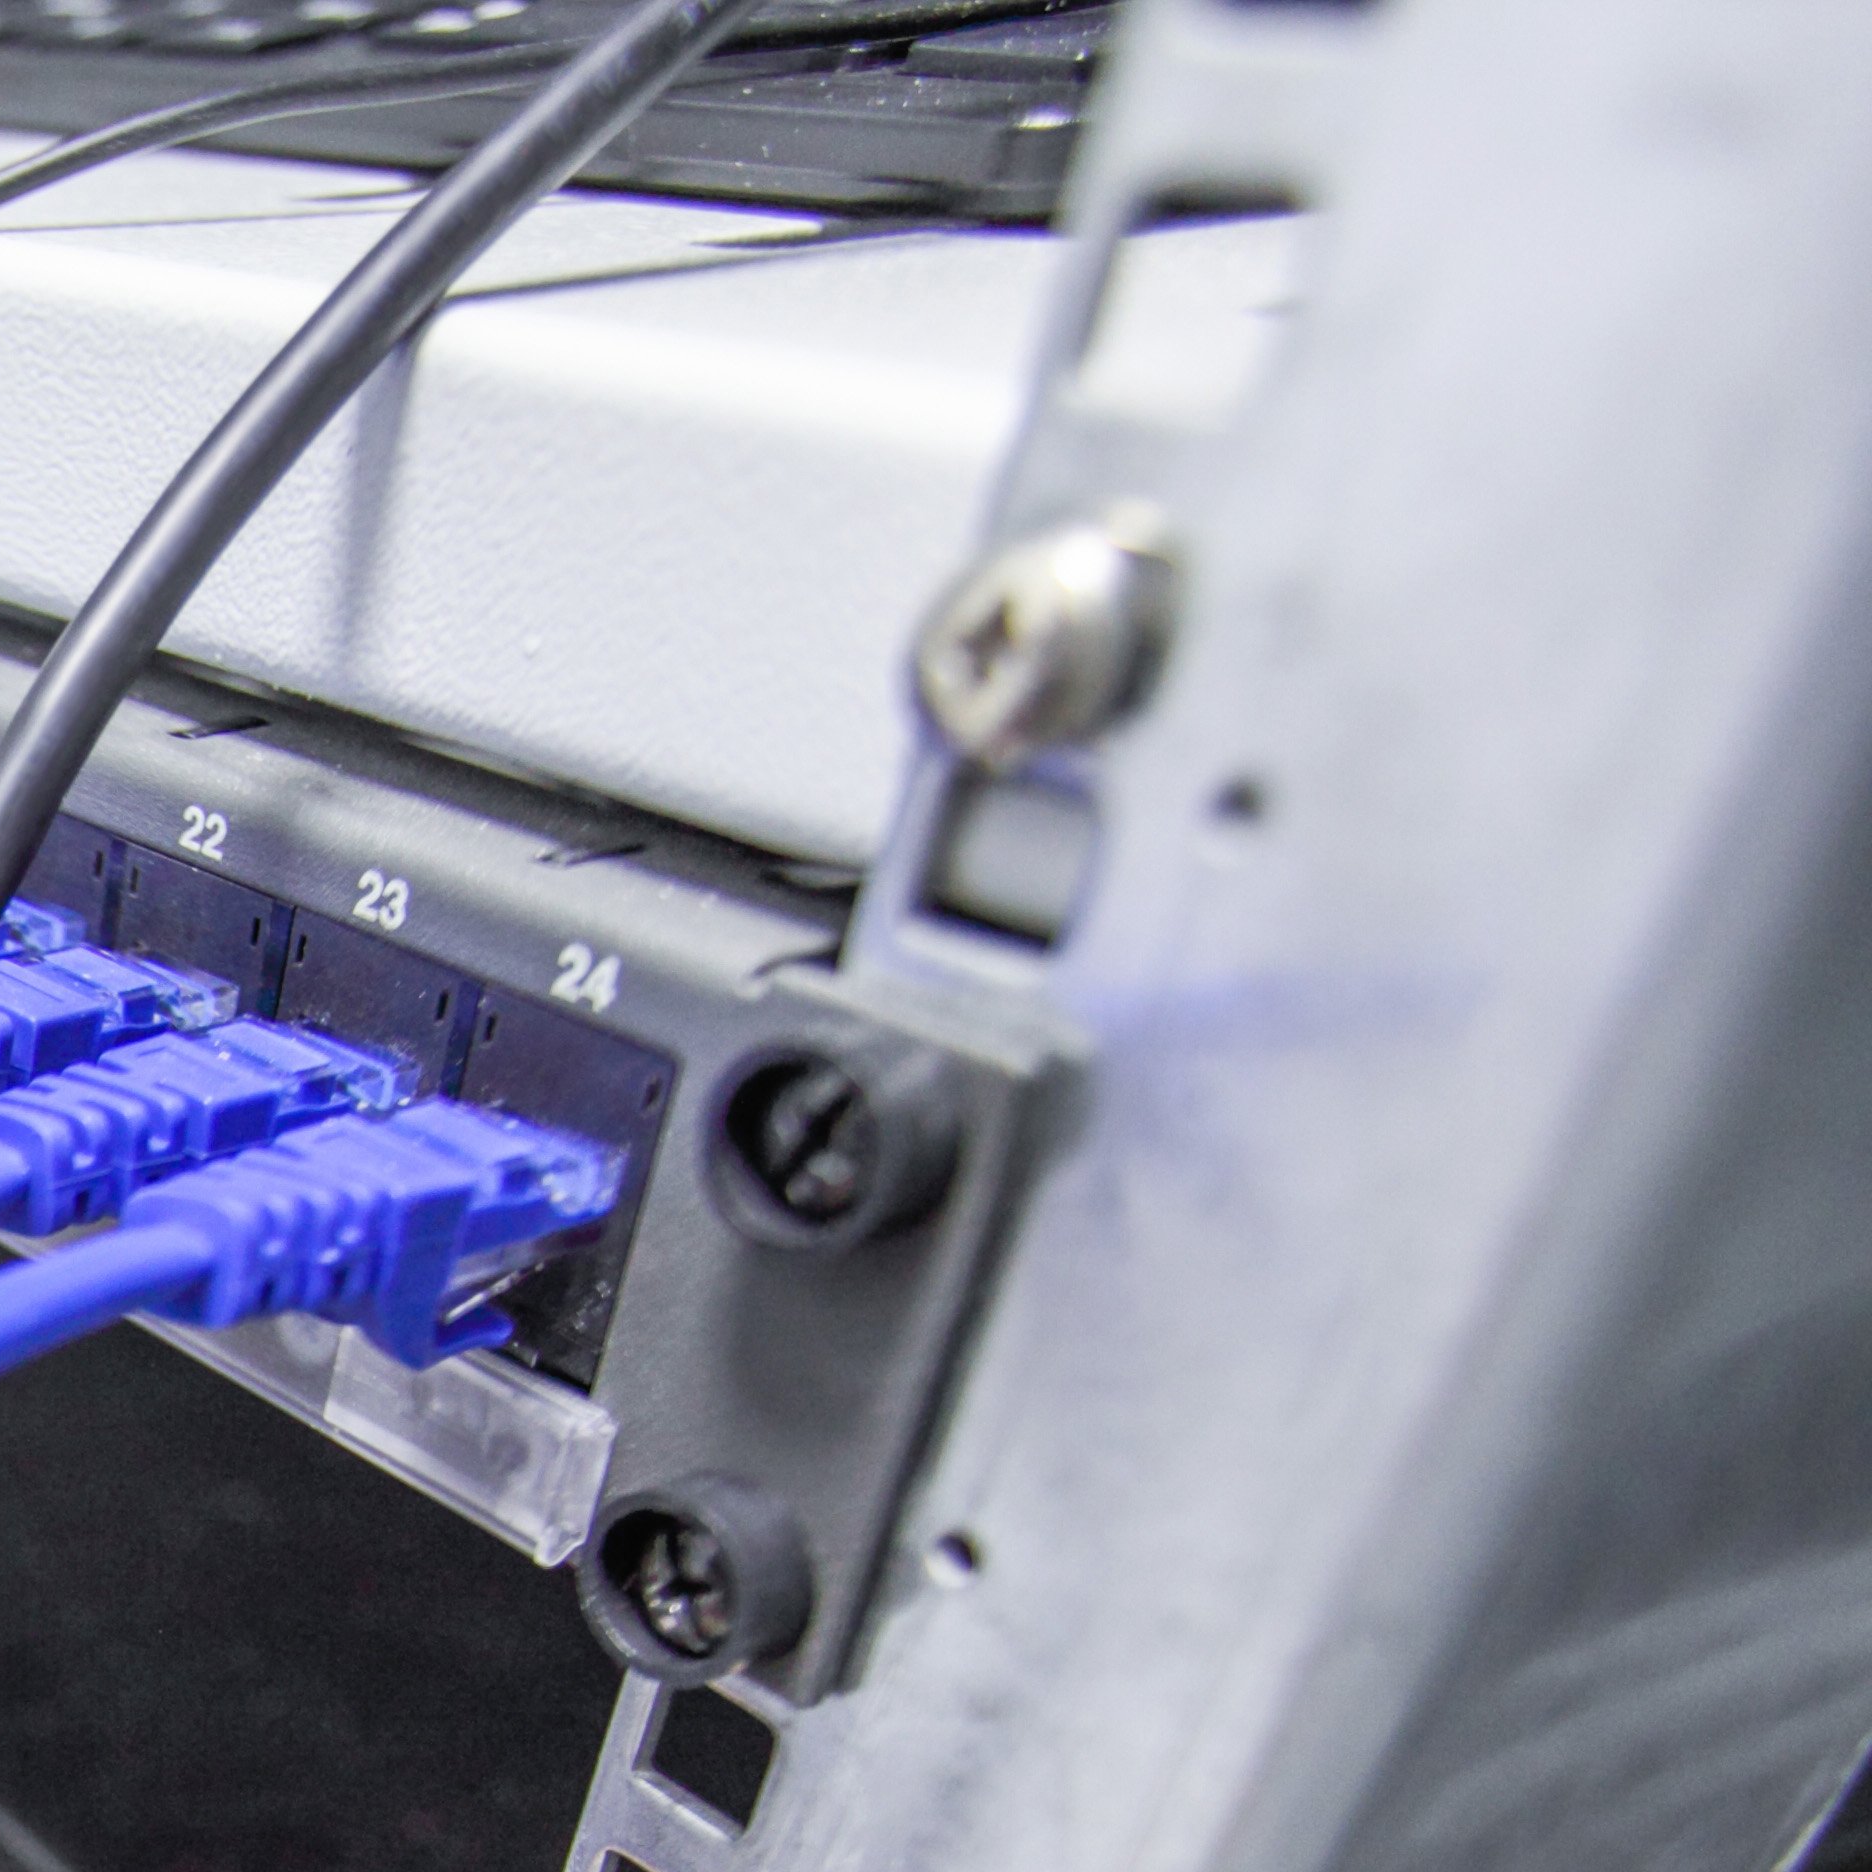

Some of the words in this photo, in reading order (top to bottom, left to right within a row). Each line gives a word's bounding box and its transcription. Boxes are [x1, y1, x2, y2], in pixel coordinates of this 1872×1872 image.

[178, 805, 228, 861] 22
[352, 868, 409, 931] 23
[550, 942, 622, 1013] 24
